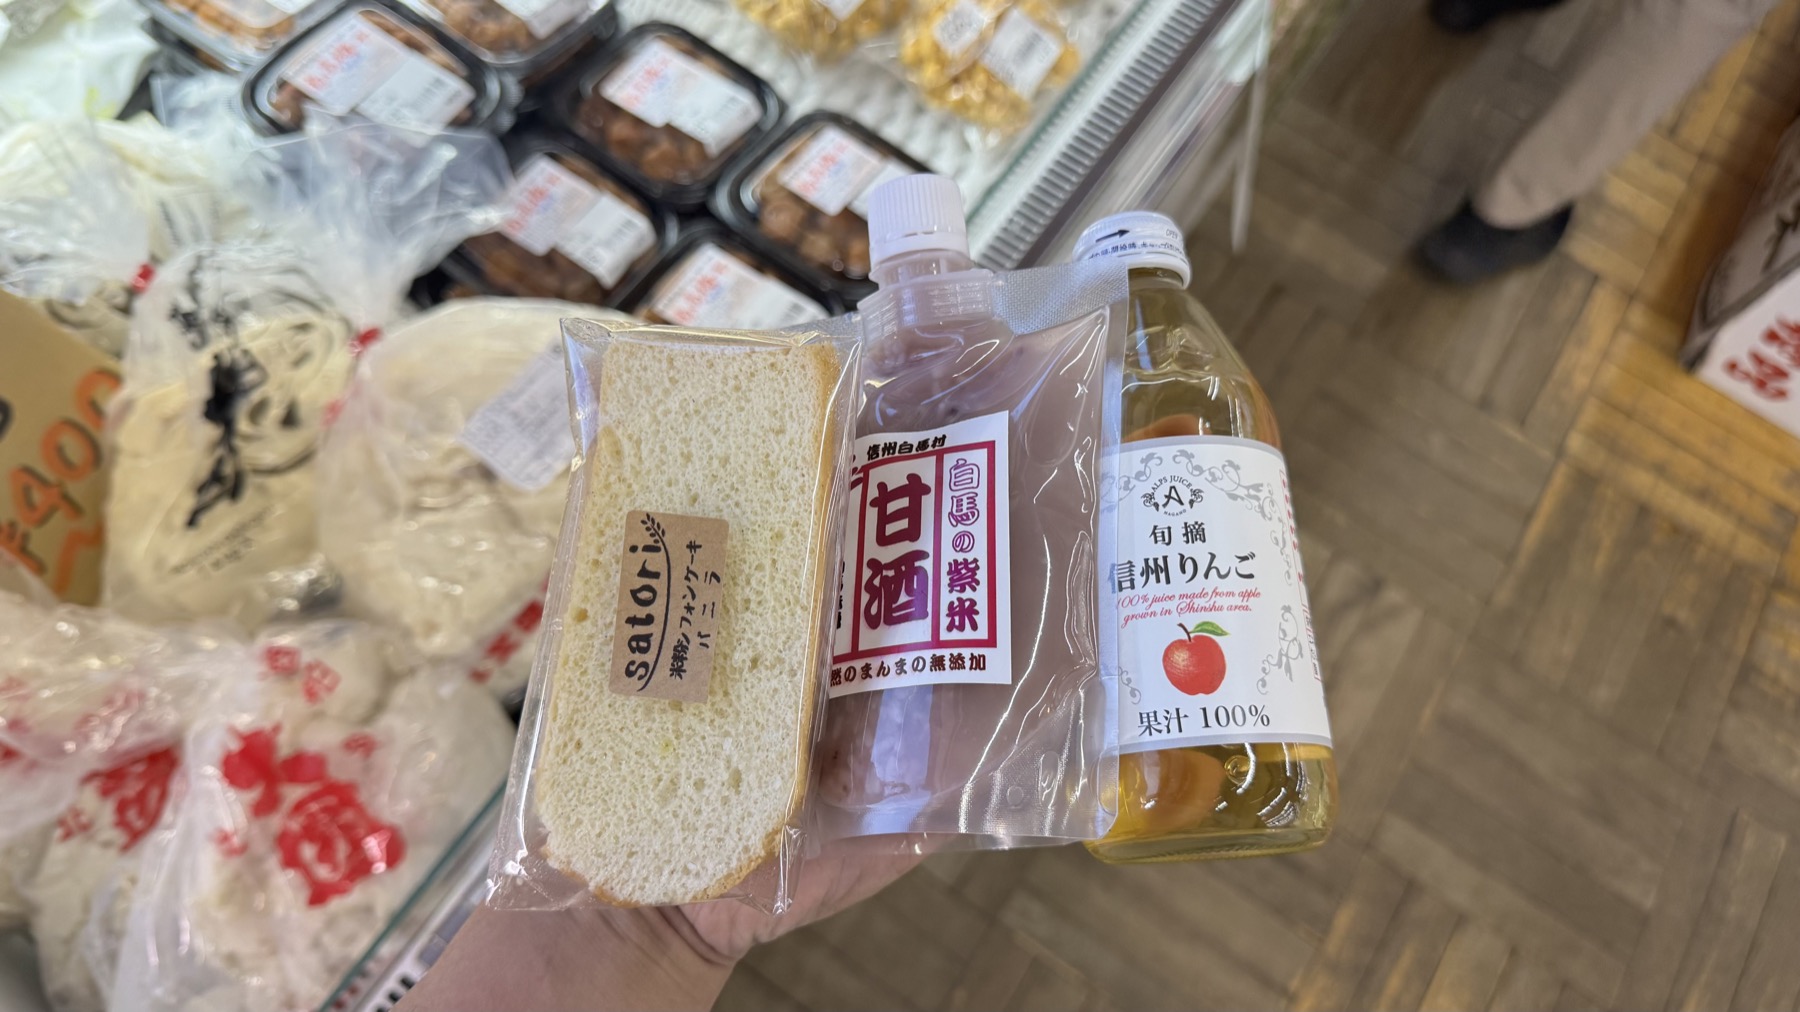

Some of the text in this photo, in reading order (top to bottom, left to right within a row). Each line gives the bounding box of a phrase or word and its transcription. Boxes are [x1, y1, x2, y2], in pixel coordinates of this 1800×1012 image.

[866, 433, 948, 461] 信州白馬村
[1151, 474, 1193, 493] ALPS JUICE
[863, 472, 932, 631] 甘酒
[945, 457, 981, 633] 白馬の紫米
[1148, 520, 1207, 546] 旬摘
[1107, 551, 1256, 594] 信州りんご
[624, 544, 662, 681] satori
[669, 539, 703, 681] 米粉シフォンケーキ
[696, 569, 721, 650] バニラ
[1117, 585, 1262, 610] 100% juice made from apple
[1120, 600, 1253, 629] grown in Shinshu area.
[1136, 703, 1271, 738] 果汁 100%
